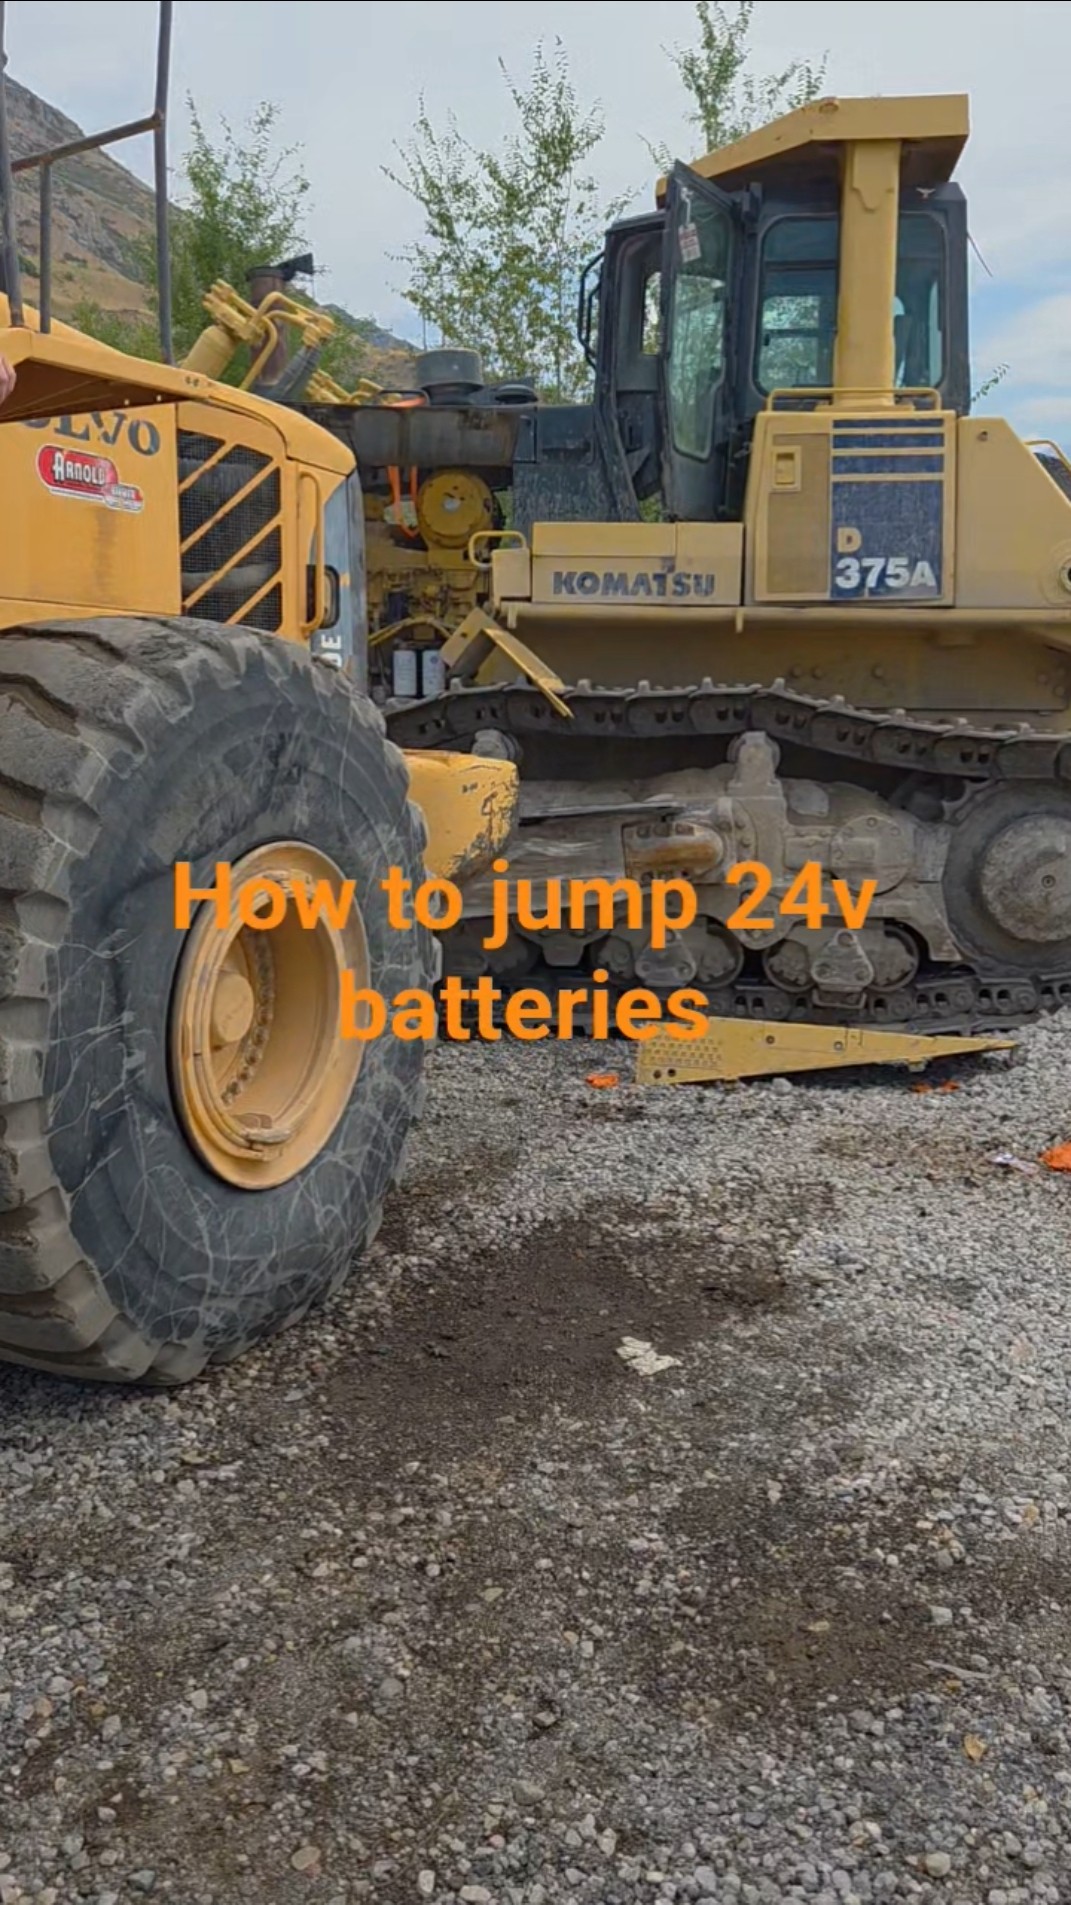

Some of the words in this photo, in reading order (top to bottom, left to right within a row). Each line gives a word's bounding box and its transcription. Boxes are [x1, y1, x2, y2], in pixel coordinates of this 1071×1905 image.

[837, 526, 862, 553] D
[552, 570, 716, 597] KOMATSU
[835, 557, 937, 589] 375A
